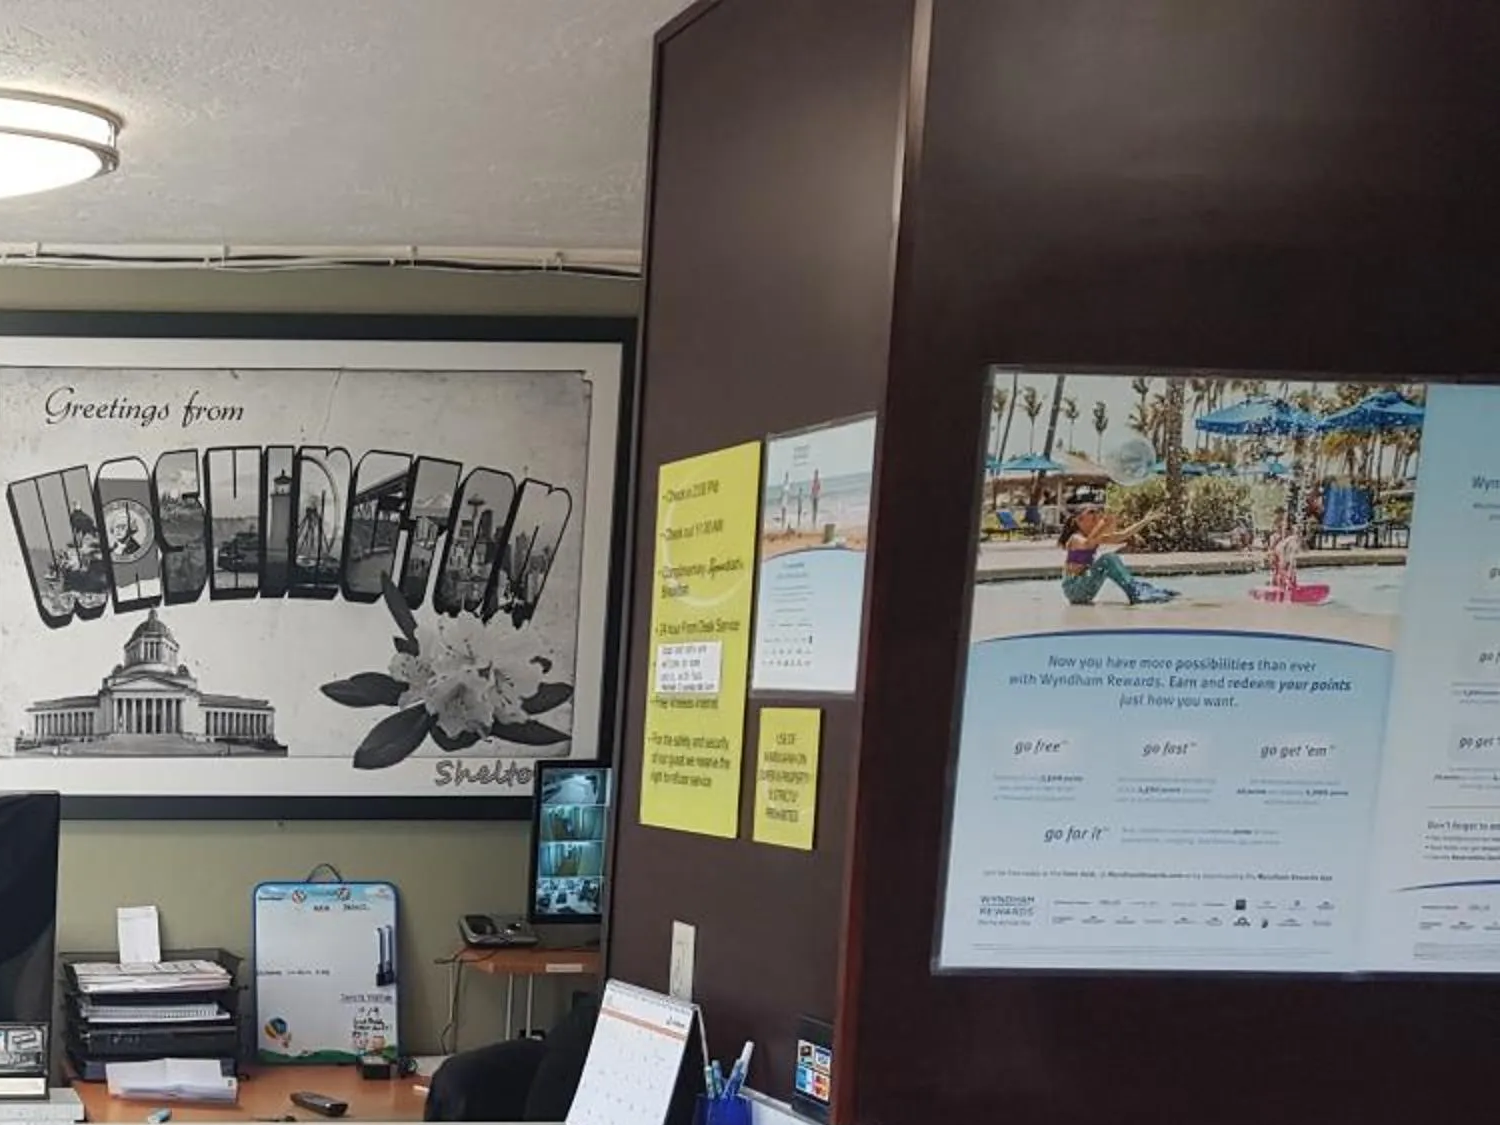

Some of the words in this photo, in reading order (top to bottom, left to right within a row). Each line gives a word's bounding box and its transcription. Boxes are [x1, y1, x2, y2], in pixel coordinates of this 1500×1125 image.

[44, 386, 170, 427] Greetings
[181, 390, 245, 427] from
[6, 444, 573, 630] WASHINGTON
[1048, 655, 1076, 668] Now
[1078, 657, 1103, 671] you
[1105, 655, 1137, 669] have
[1139, 658, 1172, 670] more
[1175, 656, 1255, 673] possibilities
[1257, 658, 1287, 671] than
[1289, 661, 1316, 673] ever
[1009, 674, 1037, 686] with
[1039, 673, 1104, 689] Wyndham
[1106, 674, 1165, 687] Rewards.
[1168, 676, 1197, 688] Earn
[1200, 675, 1225, 688] and
[1227, 677, 1276, 690] redeem
[1279, 679, 1308, 693] your
[1310, 678, 1352, 694] points
[1118, 693, 1145, 708] just
[1146, 693, 1175, 706] how
[1176, 695, 1201, 709] you
[1014, 741, 1032, 755] go
[1142, 742, 1160, 756] go
[1260, 744, 1278, 758] go
[1279, 744, 1301, 758] get
[435, 760, 535, 787] Shelto
[1043, 828, 1063, 843] go
